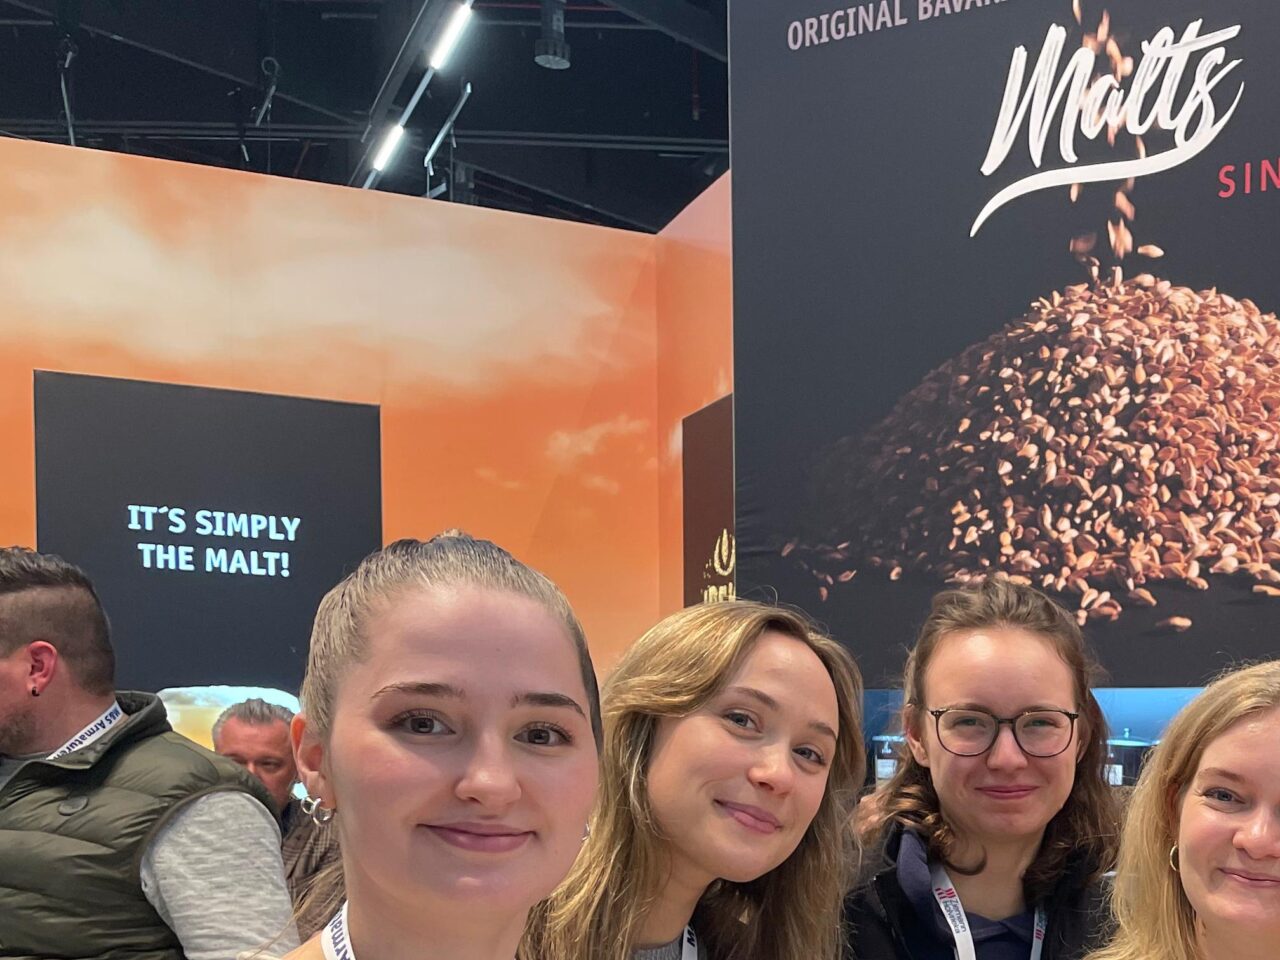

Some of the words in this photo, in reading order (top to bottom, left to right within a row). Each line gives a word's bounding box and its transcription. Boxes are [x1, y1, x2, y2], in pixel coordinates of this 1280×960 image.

[787, 0, 908, 50] ORIGINAL
[969, 18, 1244, 237] Malts
[195, 509, 301, 542] SIMPLY
[137, 542, 195, 571] THE
[205, 547, 290, 578] MALT!
